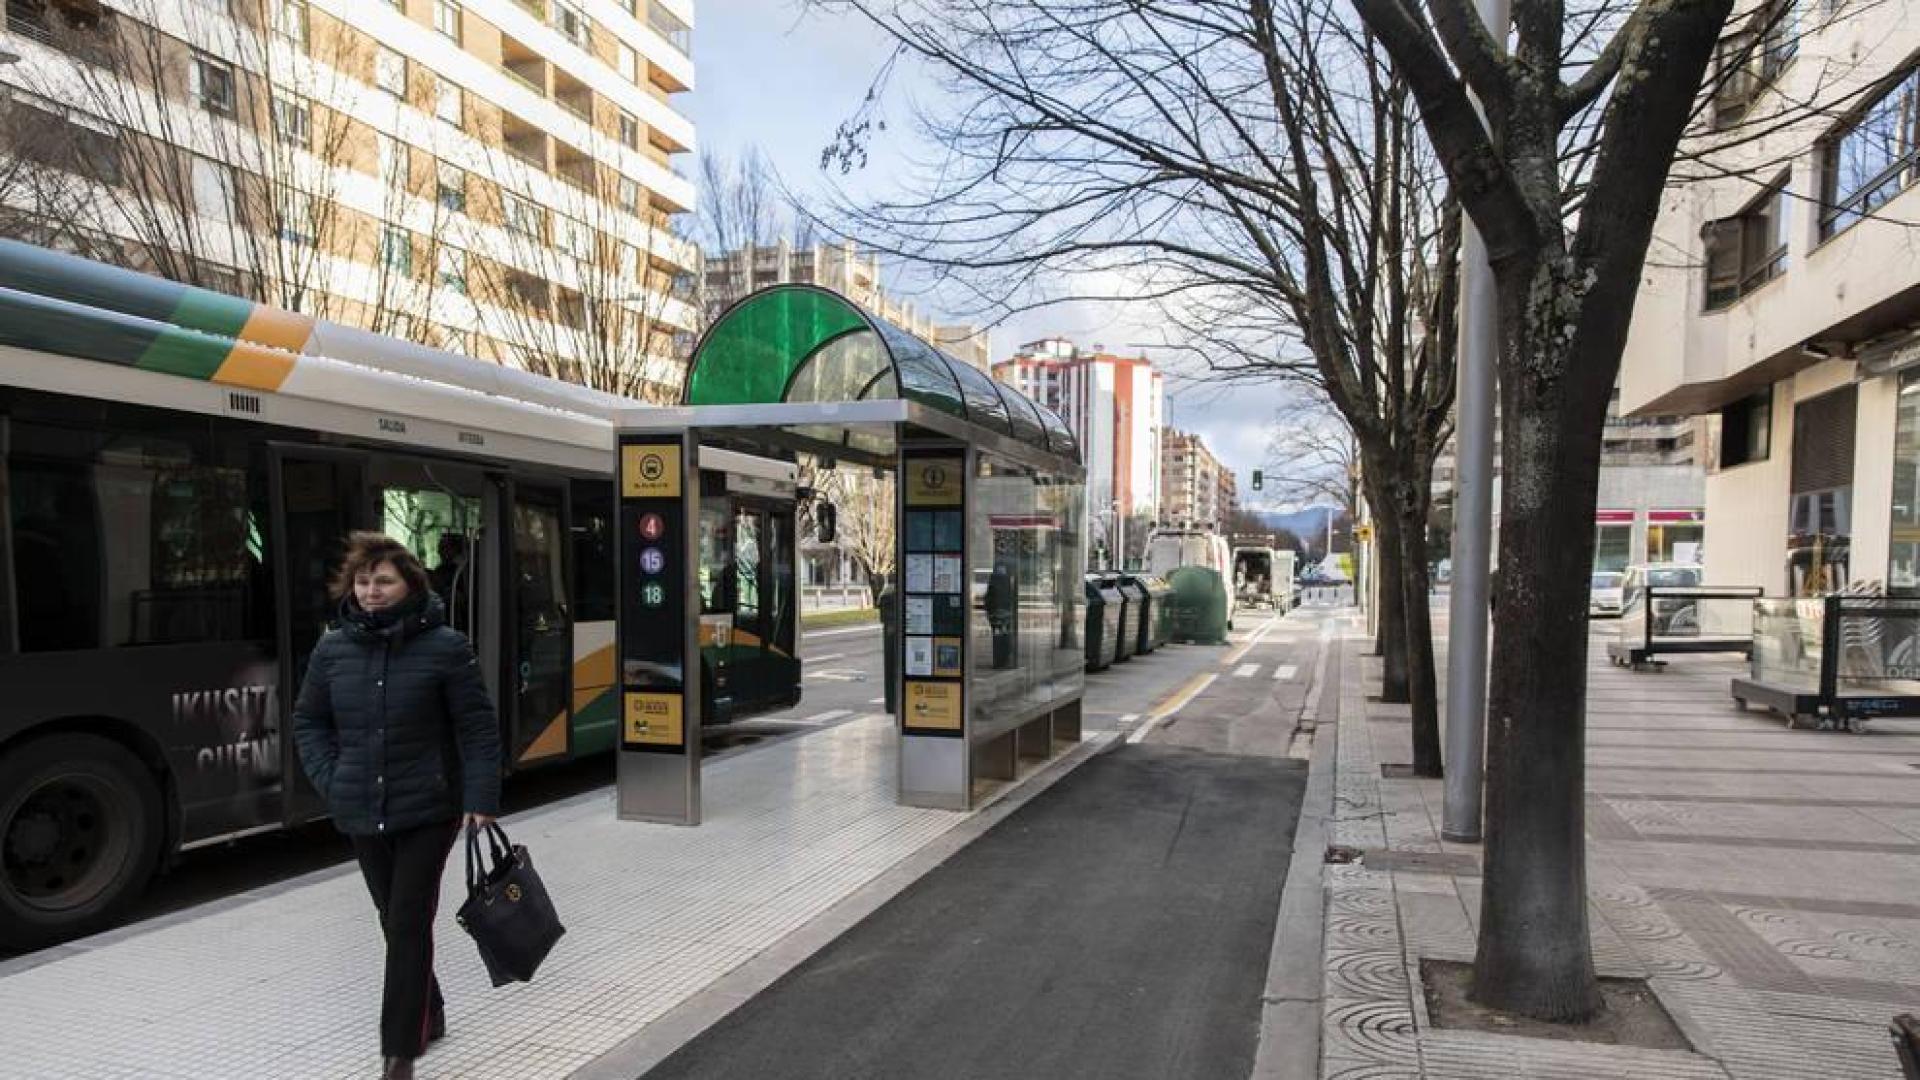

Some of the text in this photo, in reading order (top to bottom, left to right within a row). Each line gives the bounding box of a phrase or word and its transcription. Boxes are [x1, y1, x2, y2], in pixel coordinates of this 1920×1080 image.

[645, 518, 656, 536] 4
[642, 552, 661, 570] 15
[643, 586, 661, 604] 18
